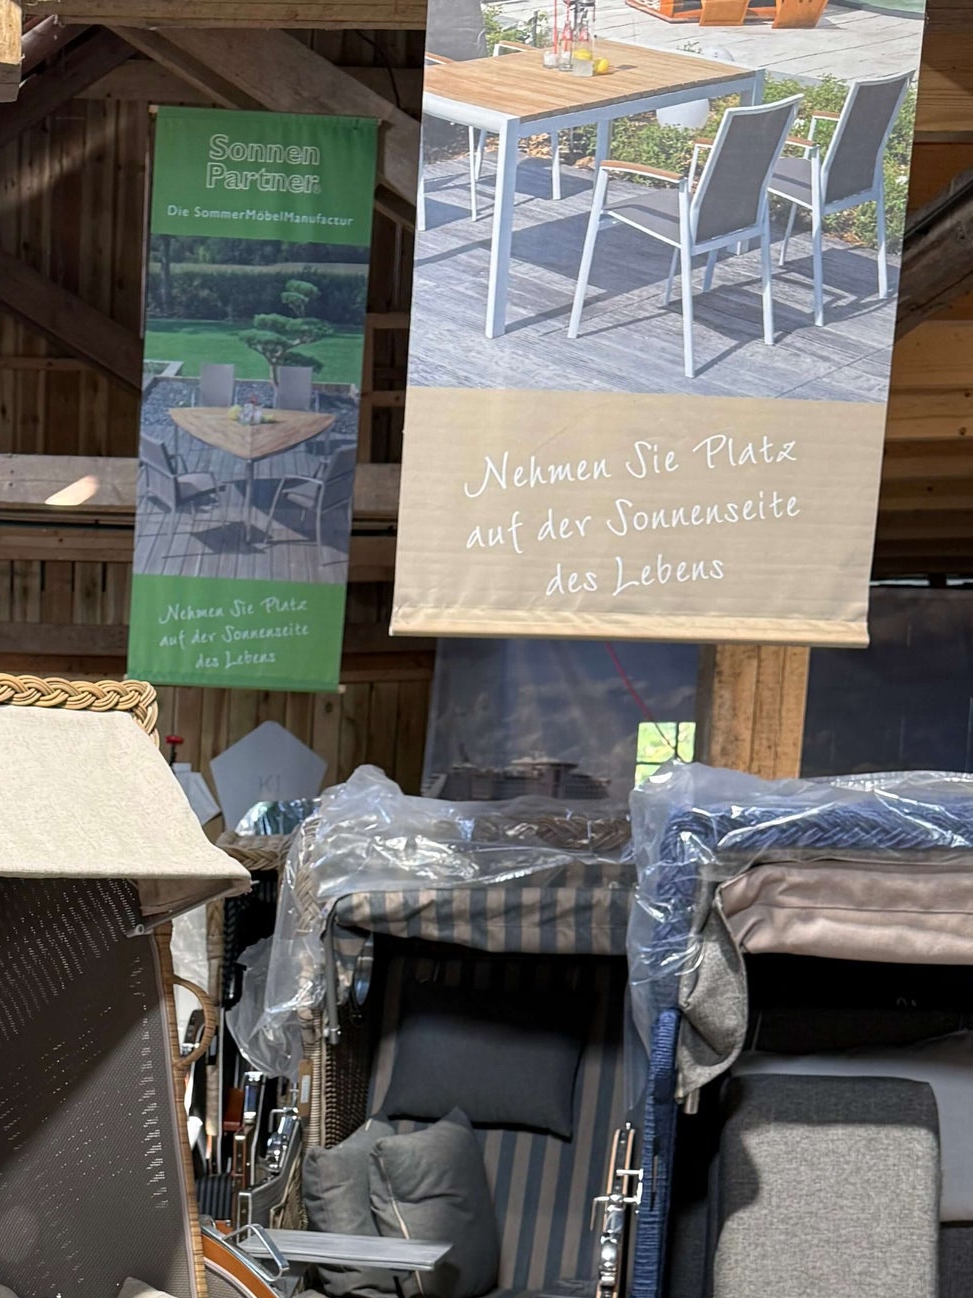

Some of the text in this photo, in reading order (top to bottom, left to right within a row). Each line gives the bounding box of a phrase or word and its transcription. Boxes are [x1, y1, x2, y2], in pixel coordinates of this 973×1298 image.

[209, 134, 320, 165] Sonnen
[167, 204, 355, 227] Die SommerMöbelManufactur
[463, 434, 797, 498] Nehmen Sie Platz
[466, 491, 802, 554] auf der Sonnenseite
[545, 554, 725, 597] des Lebens
[158, 597, 307, 625] Nehmen Sie Platz
[159, 624, 309, 650] auf der Sonnenseite
[195, 650, 276, 669] des Lebens
